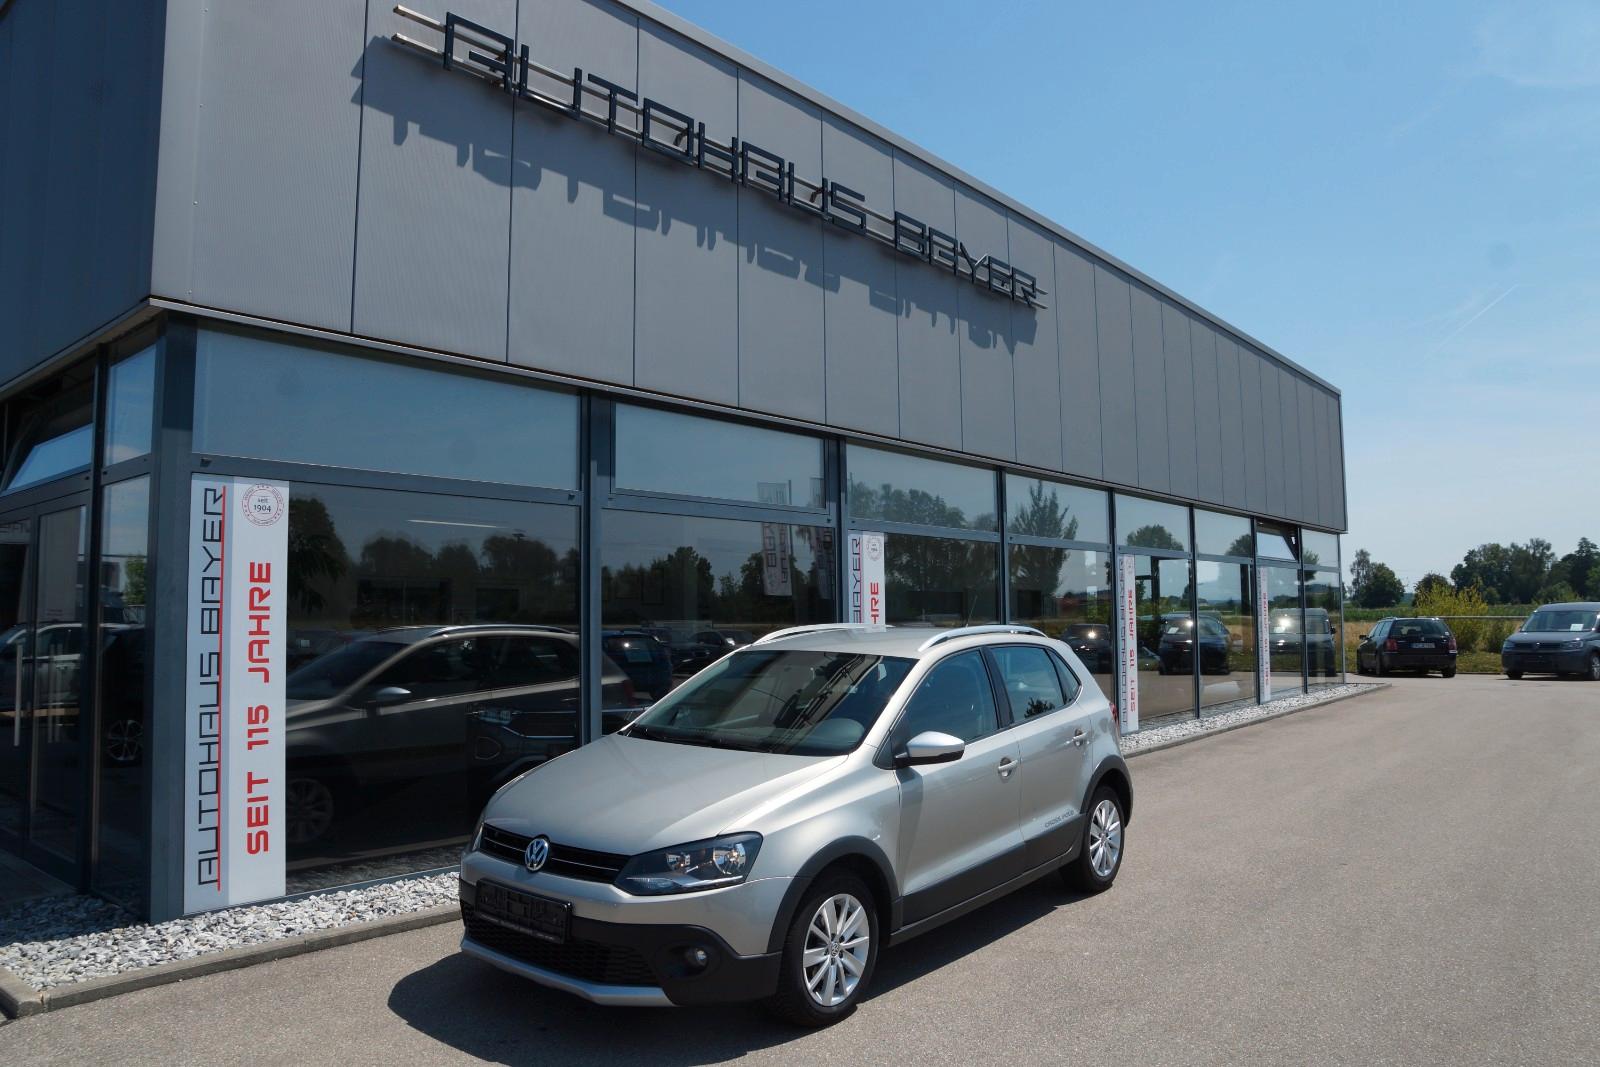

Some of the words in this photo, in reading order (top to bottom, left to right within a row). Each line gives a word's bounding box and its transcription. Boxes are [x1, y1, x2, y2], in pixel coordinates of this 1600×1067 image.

[444, 11, 866, 235] AUTOHAUS
[895, 211, 1037, 308] BAYER
[201, 487, 224, 635] BAYER
[253, 504, 272, 513] 1904
[248, 561, 272, 684] JAHRE
[198, 651, 222, 886] AUTOHAUS
[247, 704, 270, 750] 115
[247, 771, 269, 855] SEIT
